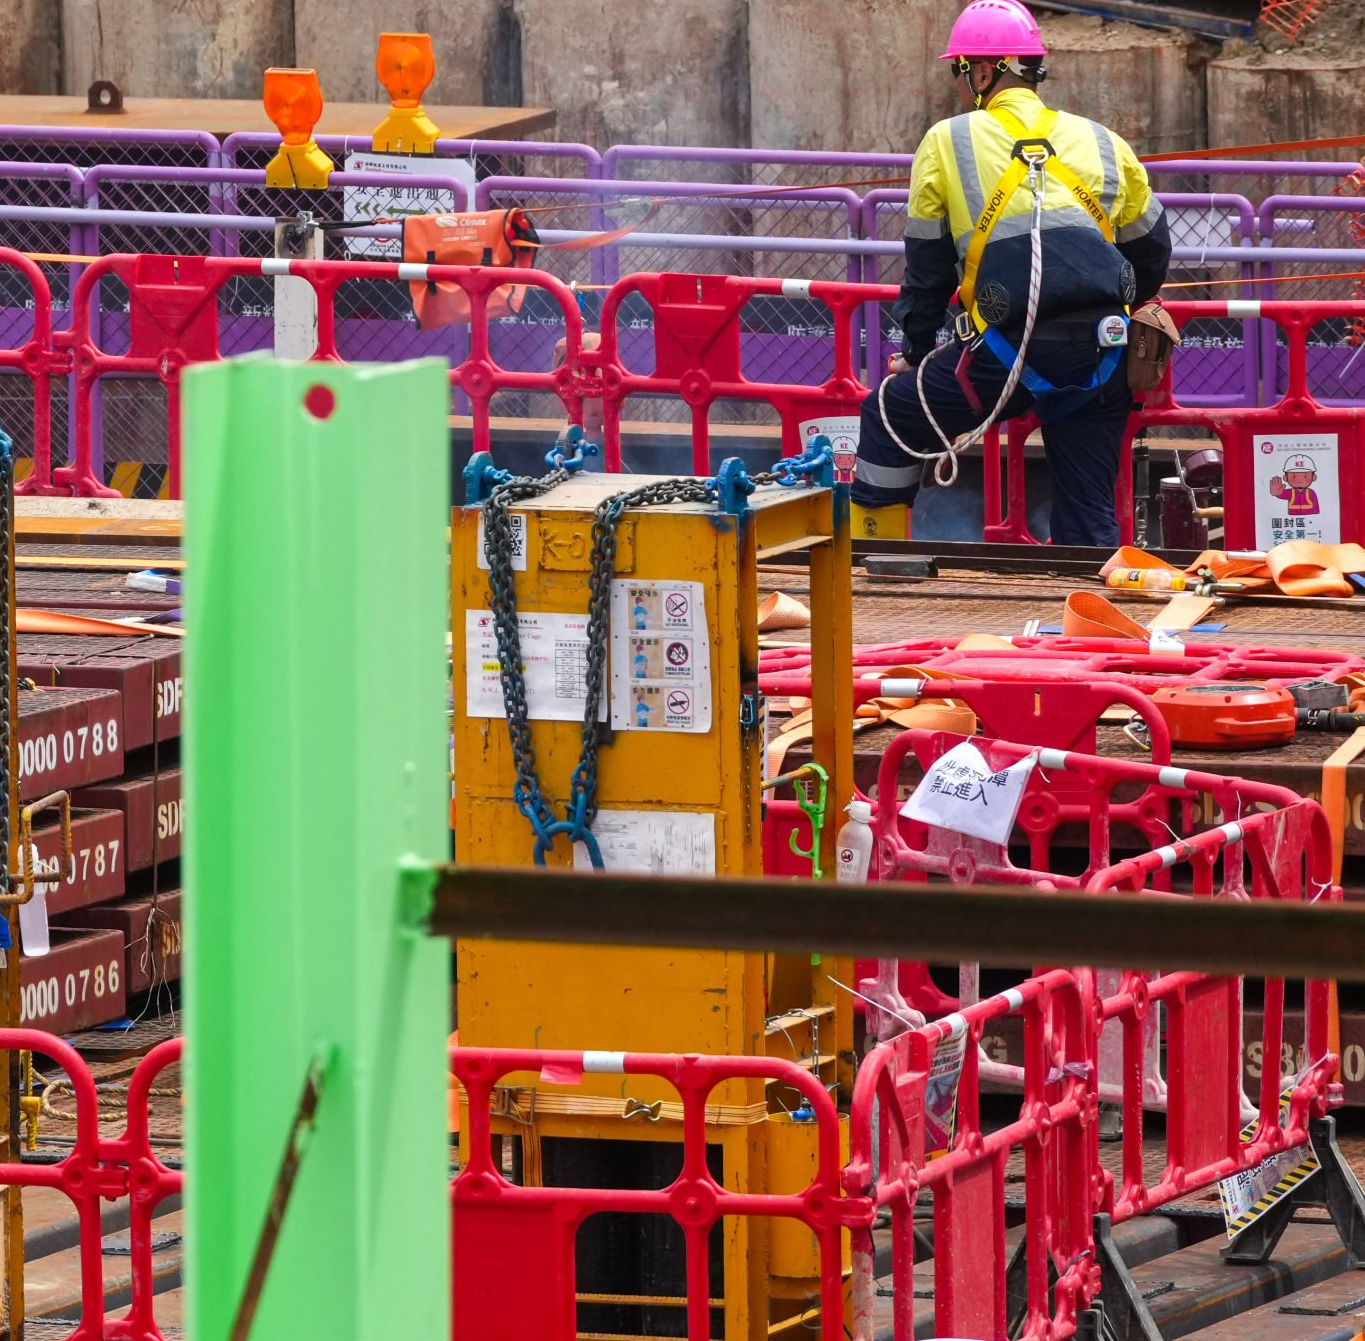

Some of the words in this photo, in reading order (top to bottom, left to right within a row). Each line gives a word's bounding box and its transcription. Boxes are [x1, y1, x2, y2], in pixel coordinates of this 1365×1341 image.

[459, 218, 487, 227] Climax
[978, 189, 1005, 233] HOATER
[1073, 185, 1104, 223] HOATER
[63, 719, 118, 764] 0788
[930, 775, 988, 806] 禁止進入
[65, 960, 120, 1007] 0786
